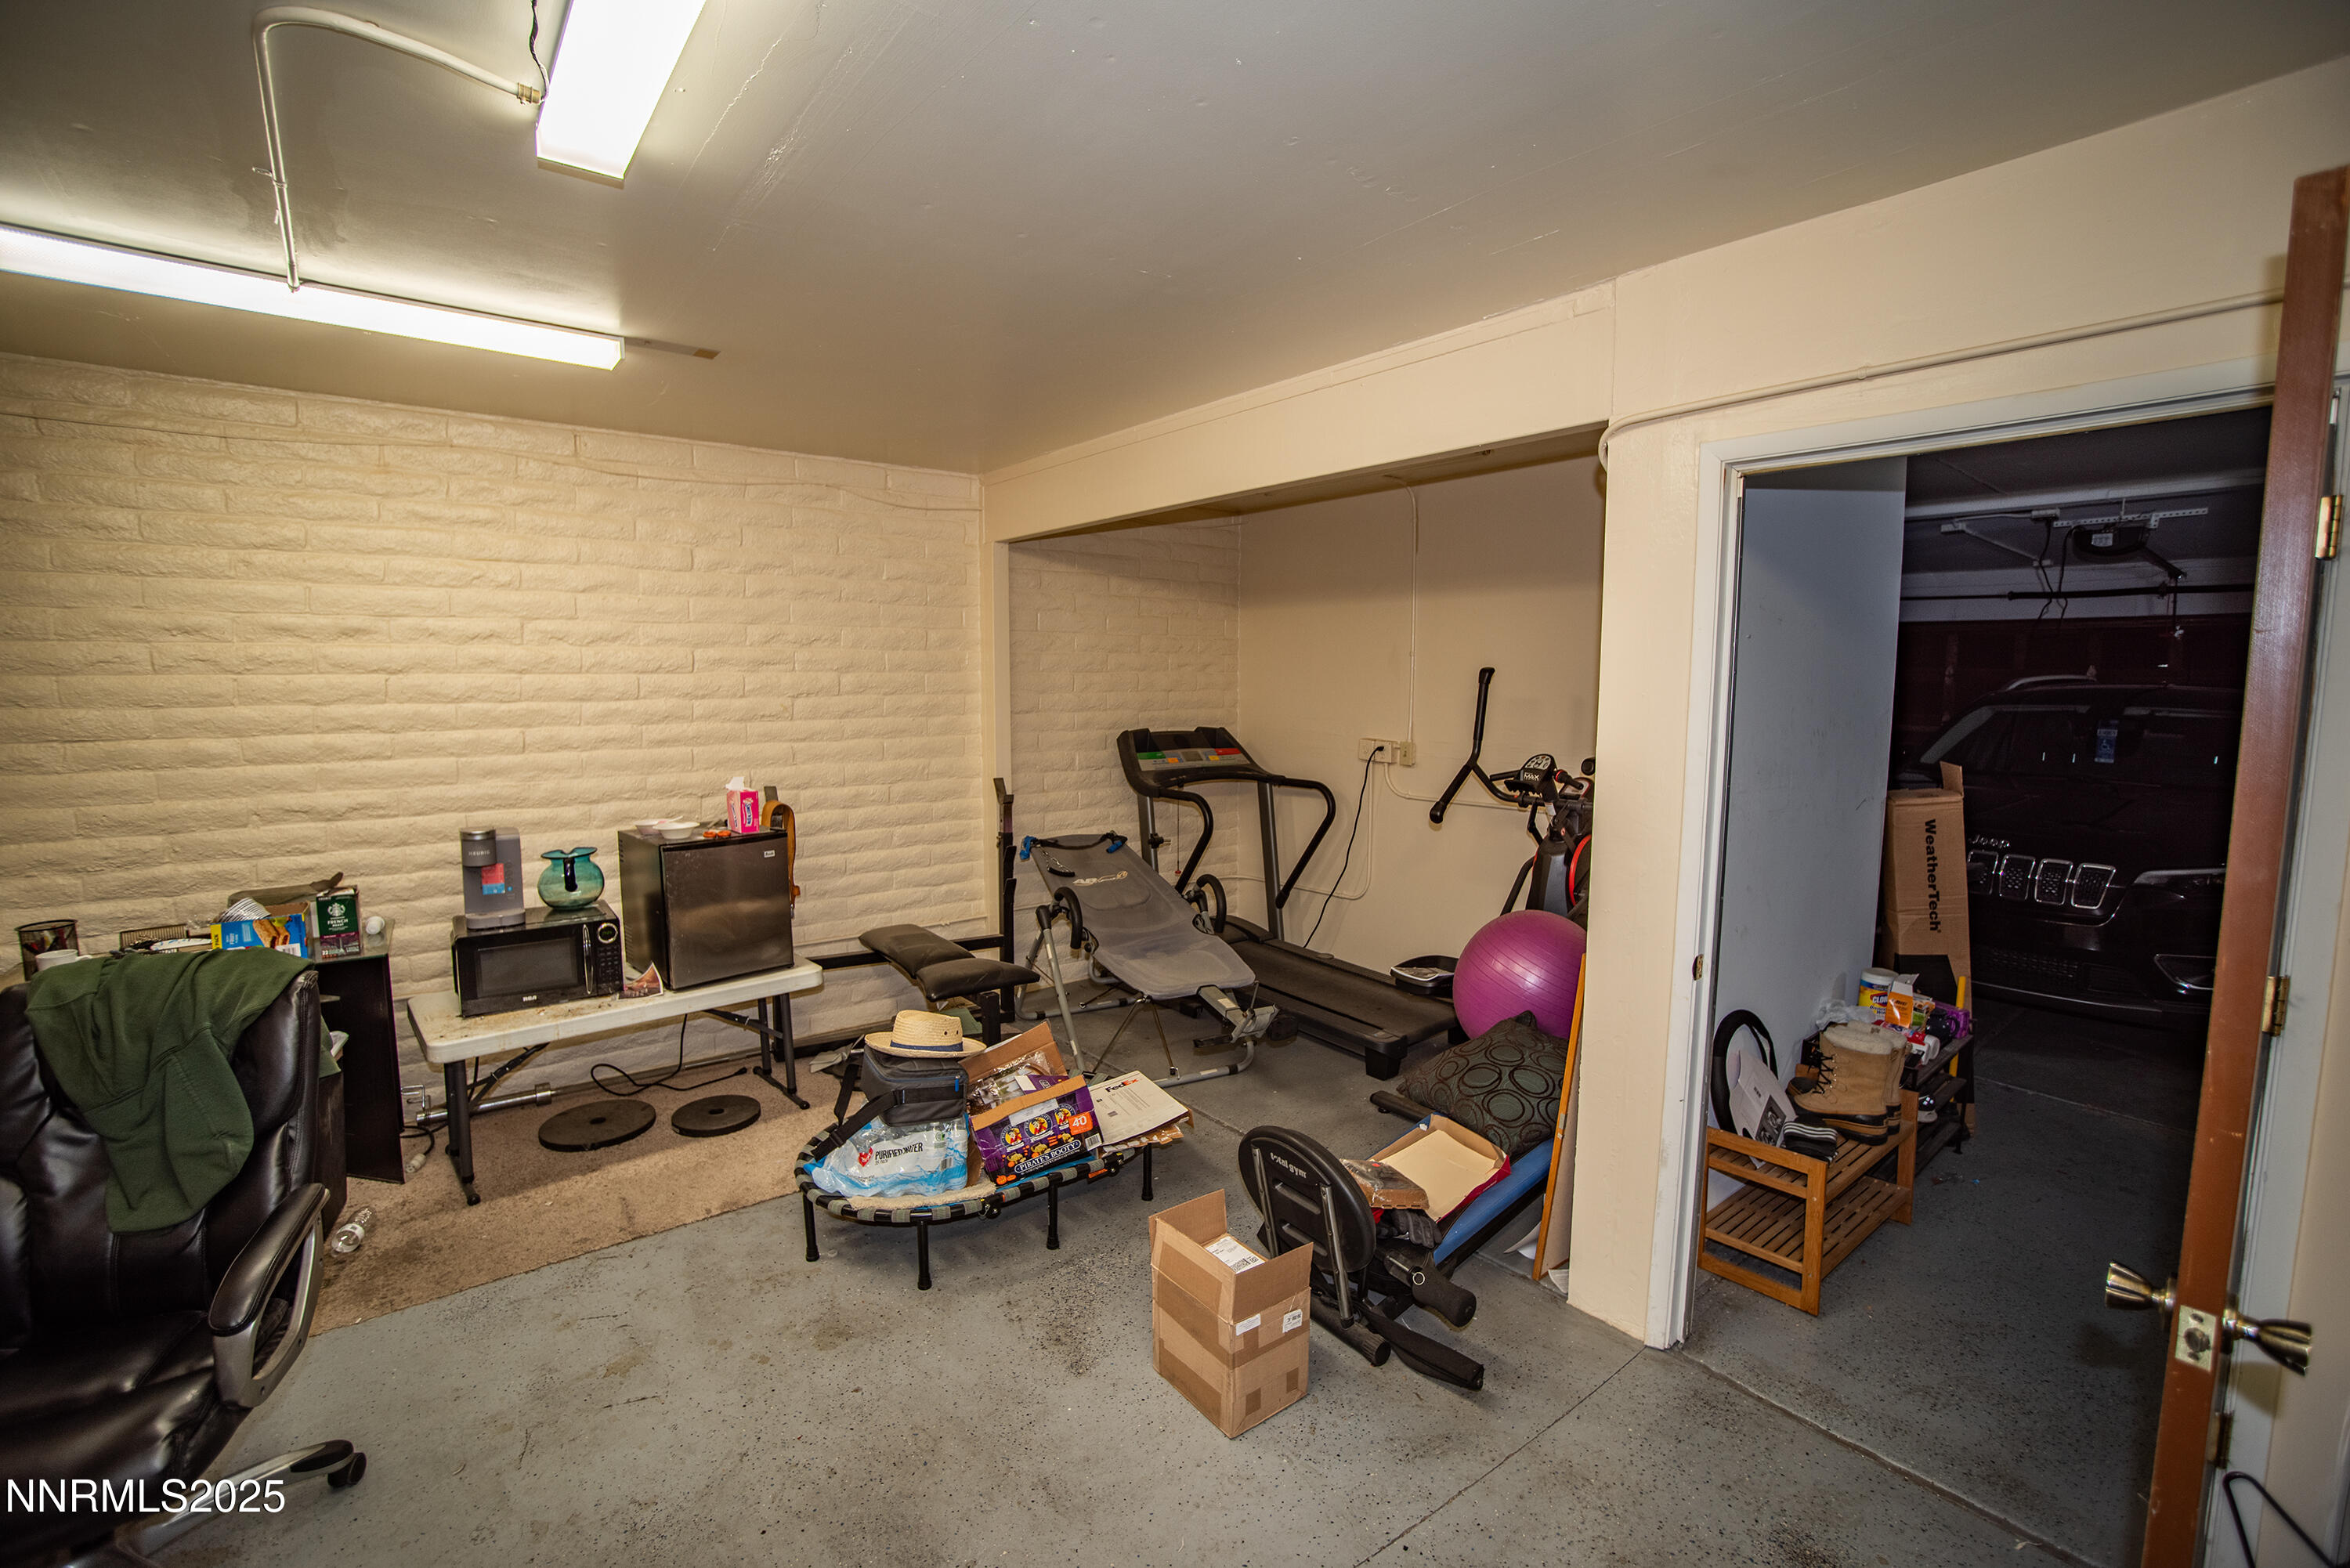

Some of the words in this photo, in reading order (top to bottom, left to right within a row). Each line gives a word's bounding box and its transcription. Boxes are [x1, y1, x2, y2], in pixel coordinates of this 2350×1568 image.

[1972, 834, 2009, 849] Jeep
[1925, 818, 1941, 931] WeatherTech
[1105, 1078, 1139, 1093] FedEx
[1072, 1115, 1087, 1127] 40
[875, 1148, 903, 1161] PURIFIED
[904, 1142, 924, 1154] WATER
[1019, 1154, 1050, 1170] PIRATE'S
[1050, 1142, 1076, 1160] BOOTY
[1270, 1152, 1289, 1169] total
[1289, 1163, 1307, 1179] gym
